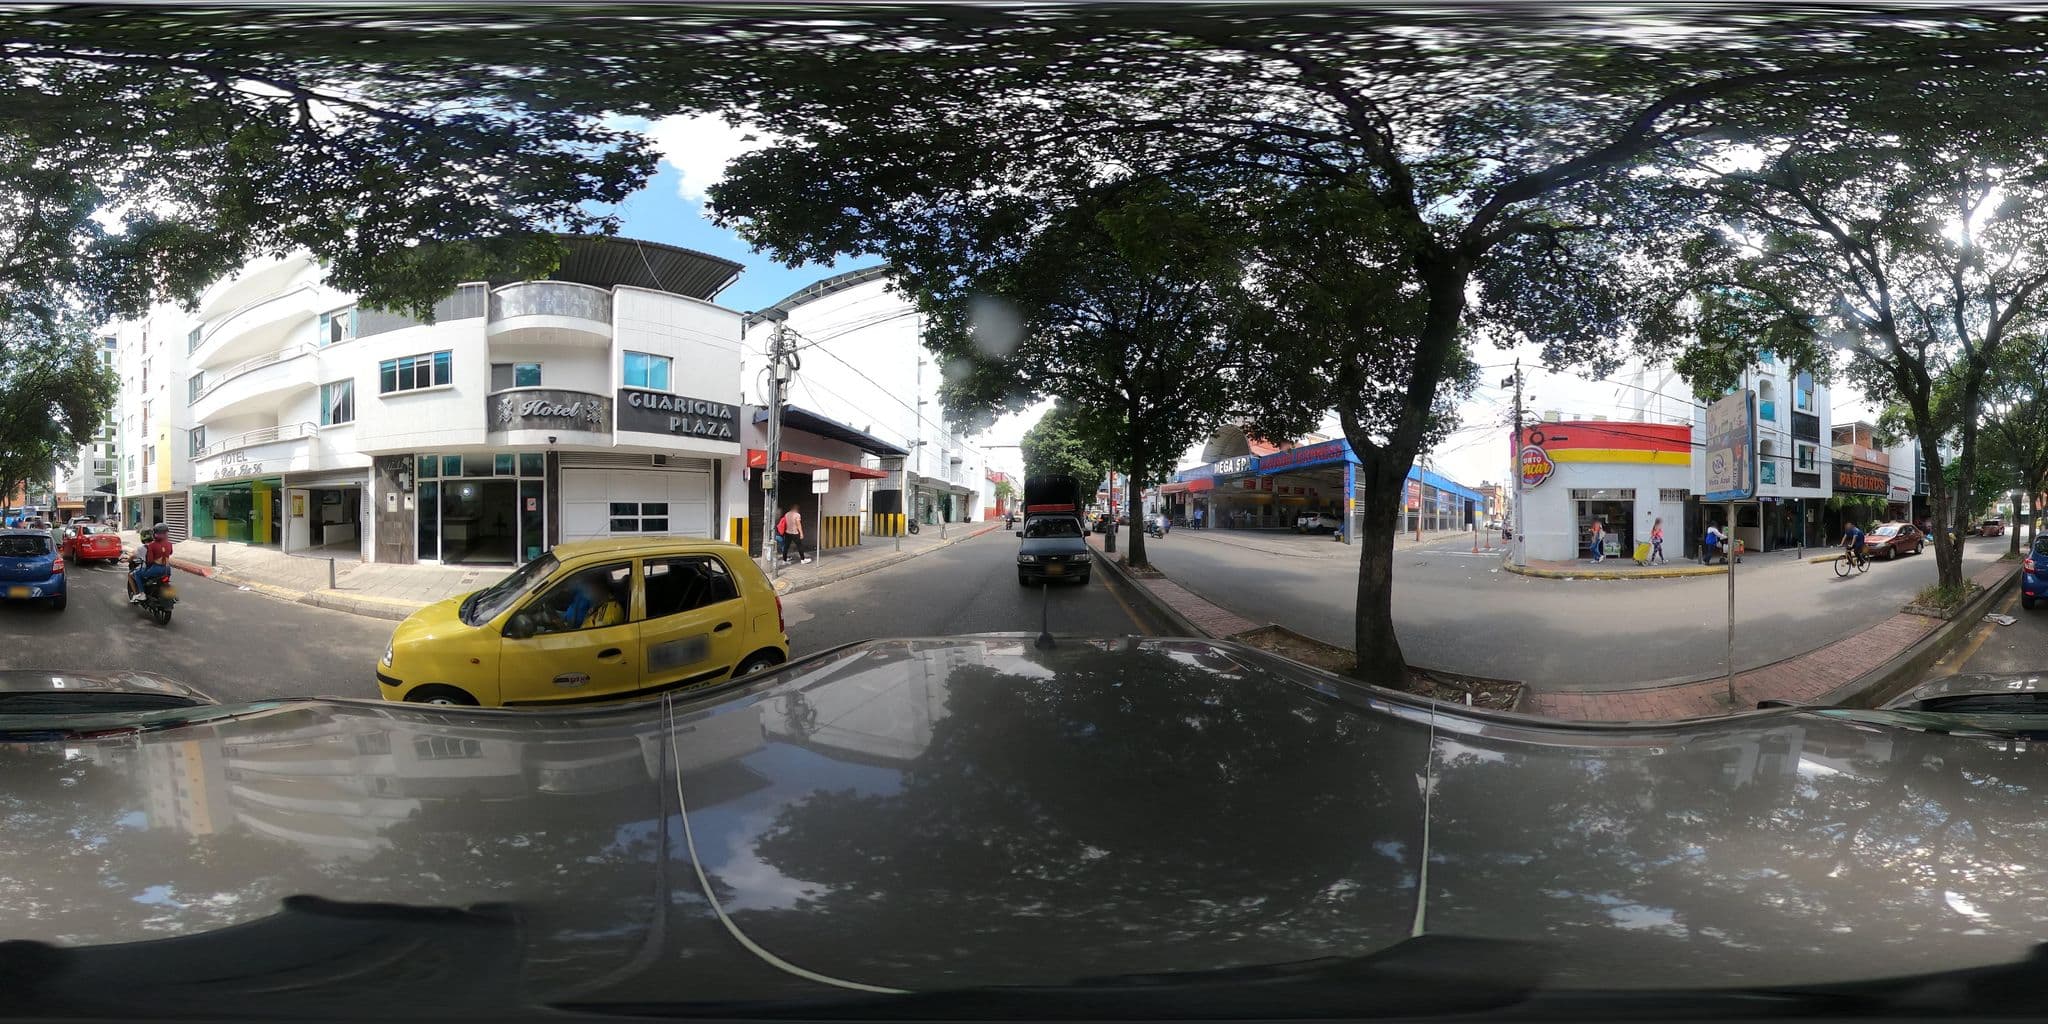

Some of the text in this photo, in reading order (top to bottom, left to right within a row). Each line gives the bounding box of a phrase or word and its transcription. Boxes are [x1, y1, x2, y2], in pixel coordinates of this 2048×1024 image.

[520, 399, 580, 418] Hotel
[628, 392, 732, 419] GUARIGUA
[669, 416, 732, 437] PLAZA
[221, 450, 248, 465] HOTEL
[1214, 459, 1233, 473] MEGA
